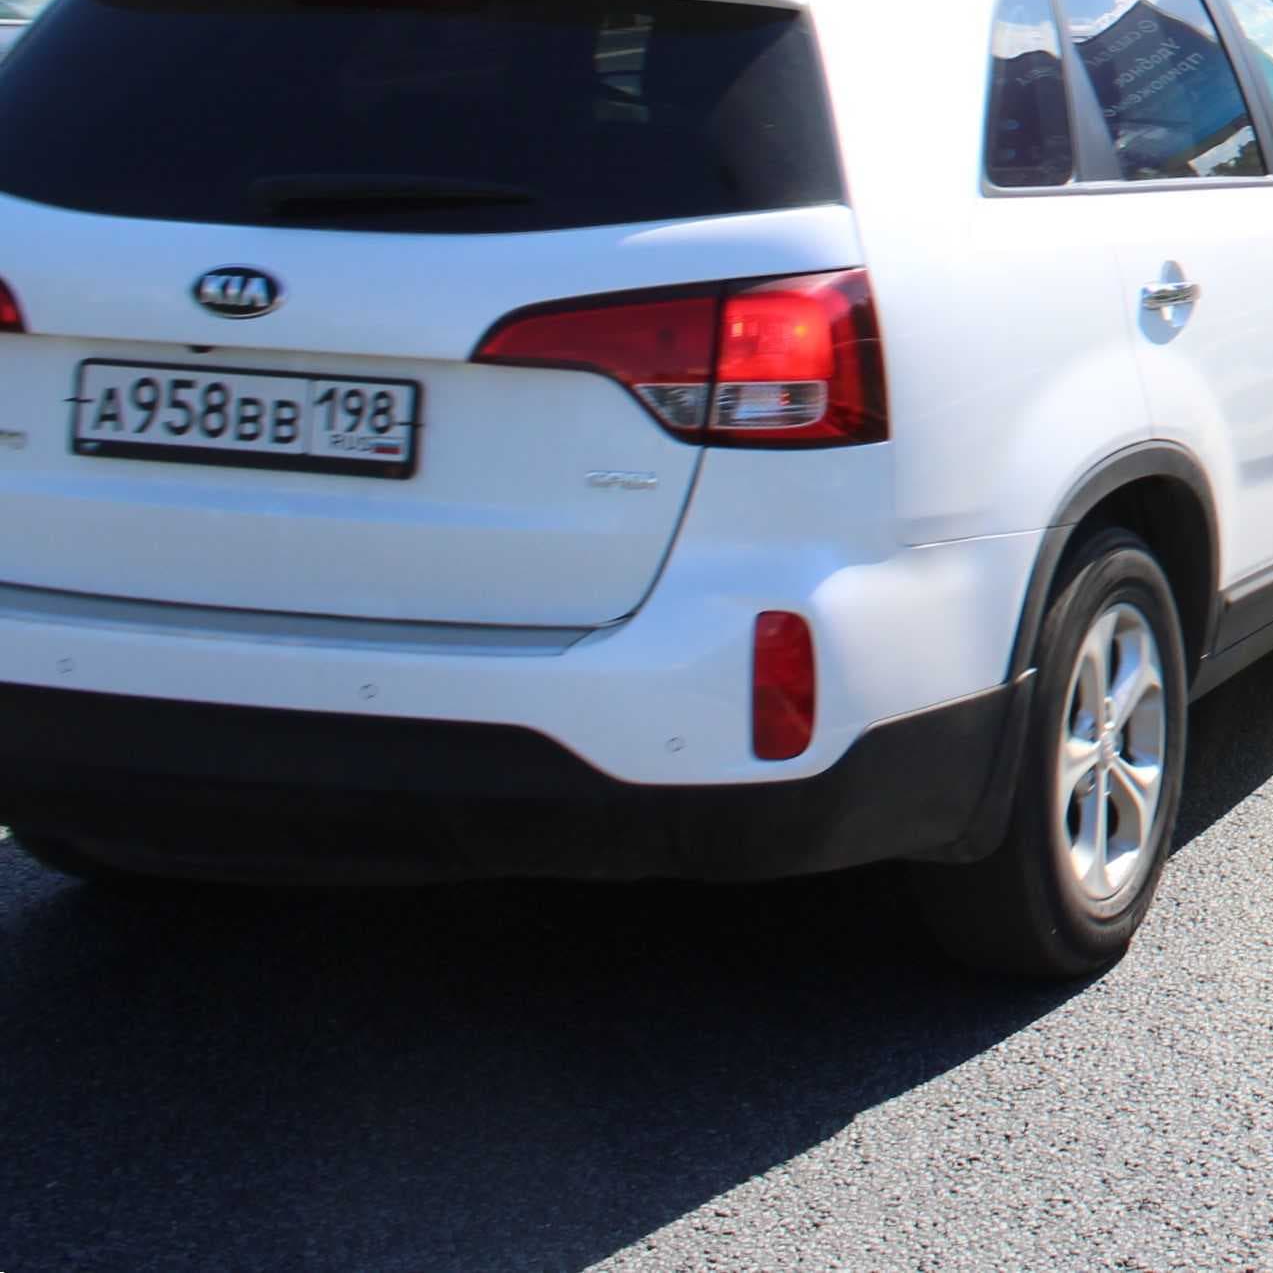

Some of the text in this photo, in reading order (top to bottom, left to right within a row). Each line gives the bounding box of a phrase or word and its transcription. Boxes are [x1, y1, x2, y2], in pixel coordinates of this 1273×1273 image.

[200, 275, 270, 307] KIA
[94, 377, 397, 445] А958ВВ 198
